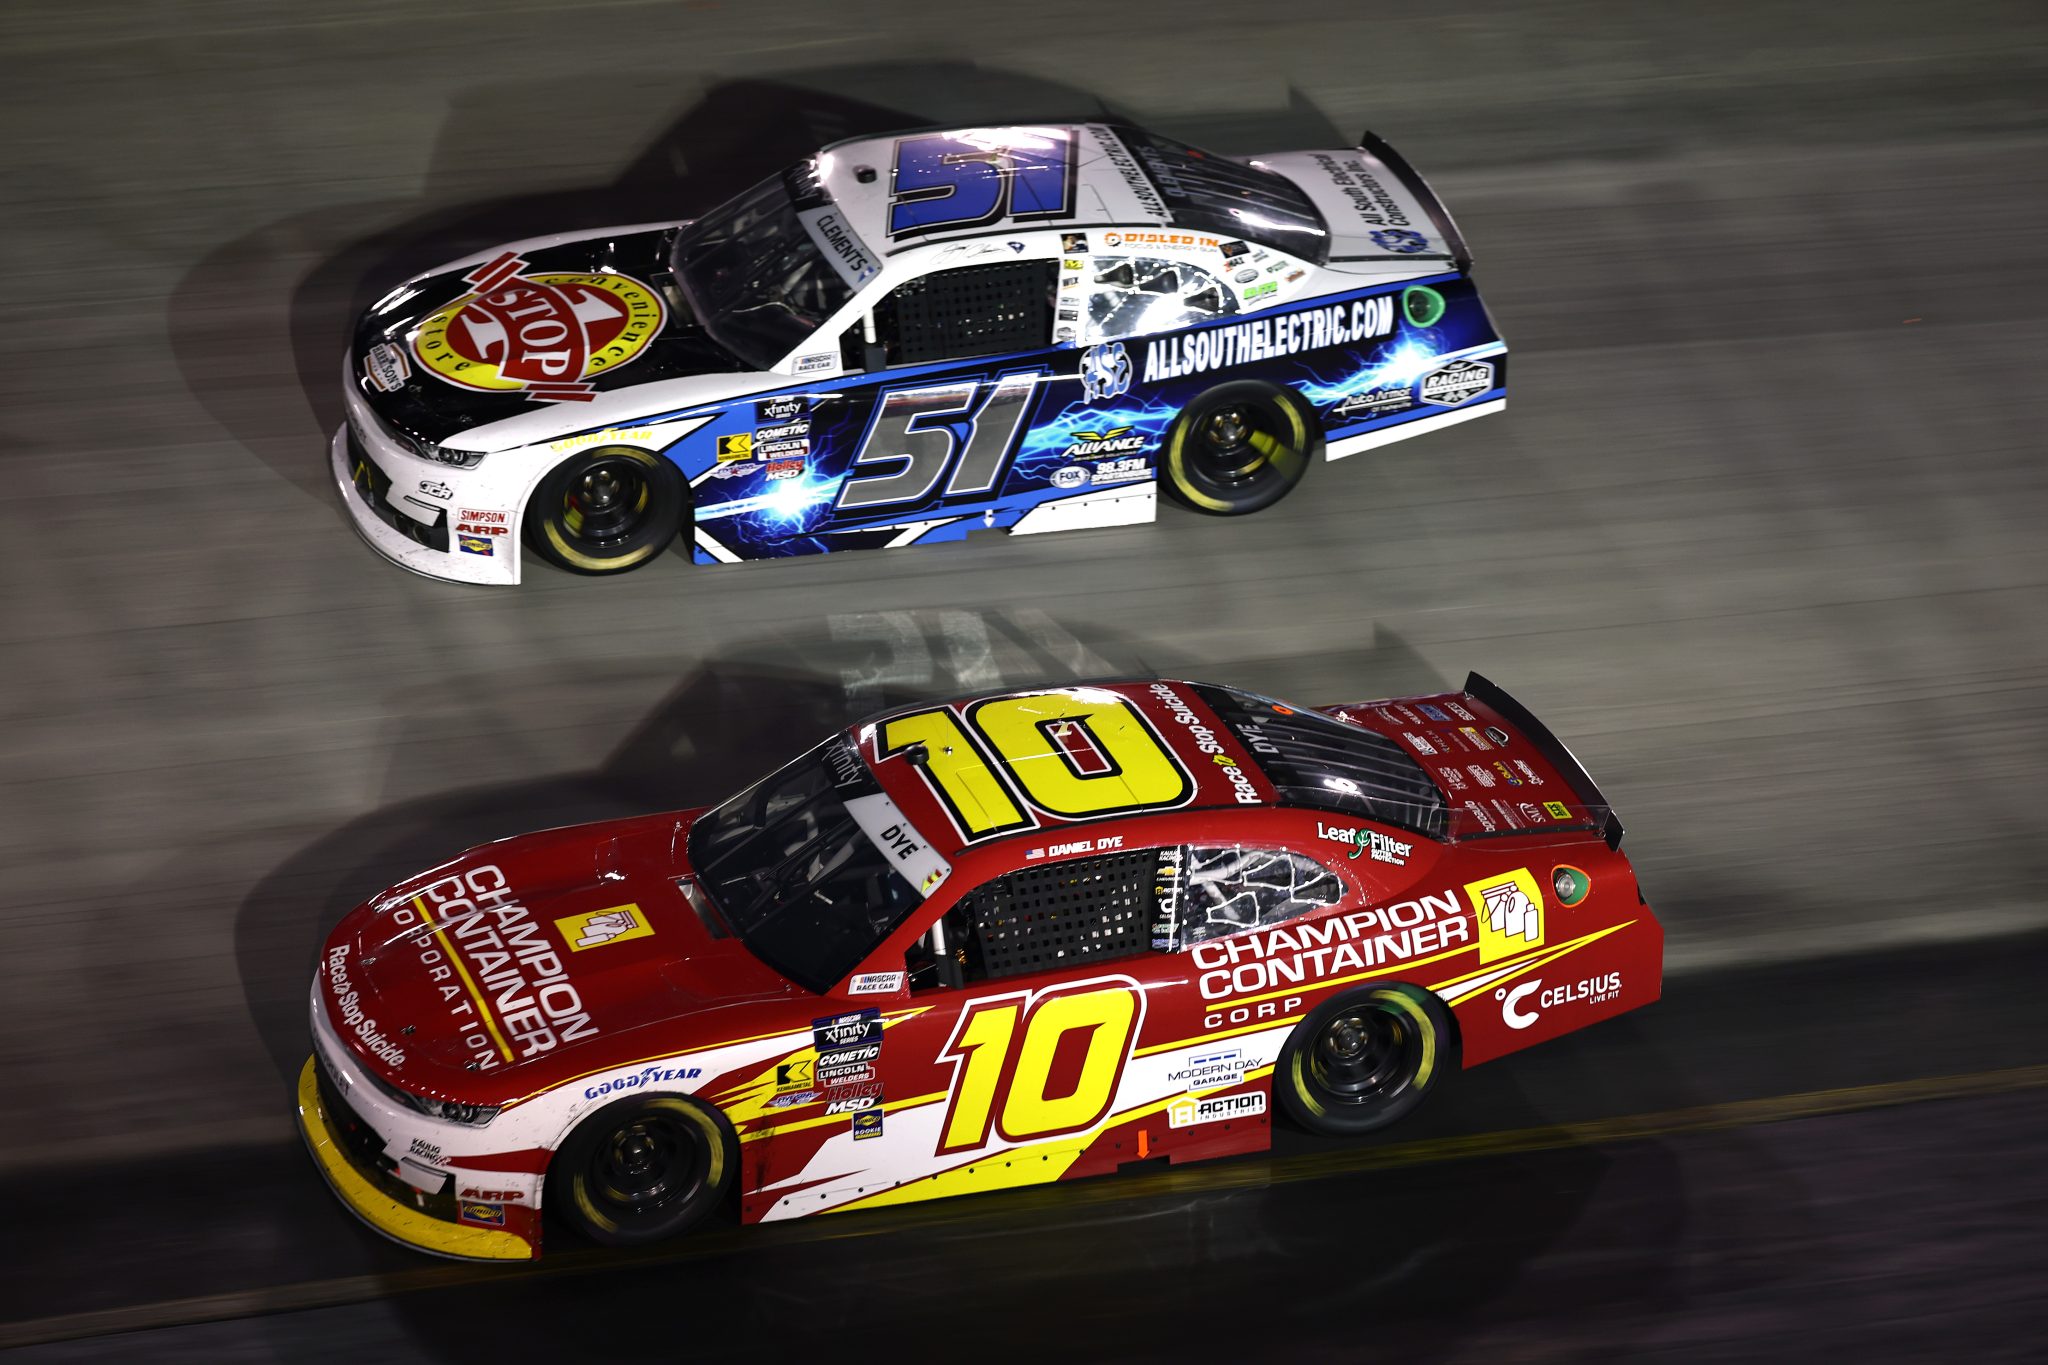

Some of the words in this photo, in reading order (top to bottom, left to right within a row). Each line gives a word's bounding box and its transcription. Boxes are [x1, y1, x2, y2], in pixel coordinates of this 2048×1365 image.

[816, 215, 868, 271] CLEMENTS
[484, 287, 571, 385] STOP
[1142, 296, 1394, 384] ALLSOUTHELECTRIC.COM
[1427, 368, 1487, 388] RACING
[764, 402, 801, 417] xfinity
[756, 424, 810, 440] COMETIC
[837, 373, 1039, 509] 51
[761, 442, 800, 452] LINCOLN
[1061, 436, 1145, 457] ALLIANCE
[765, 470, 800, 482] MSD
[1059, 471, 1081, 480] FOX
[1096, 458, 1146, 474] 98.3FM
[461, 510, 505, 523] SIMPSON
[456, 523, 508, 535] ARP
[1149, 684, 1200, 725] Suicide
[1188, 725, 1224, 754] Stop
[876, 688, 1197, 845] 10
[1222, 766, 1262, 803] Race
[880, 824, 919, 860] DYE
[1048, 840, 1095, 857] DANIEL
[1097, 836, 1124, 850] DYE
[1317, 822, 1356, 844] Leaf
[1366, 830, 1412, 857] Filter
[1190, 889, 1462, 970] CHAMPION
[329, 944, 350, 984] Race
[465, 864, 600, 1043] CHAMPION
[1199, 915, 1469, 999] CONTAINER
[425, 876, 558, 1058] CONTAINER
[856, 983, 877, 991] RACE
[1541, 971, 1621, 1009] CELSIUS
[1590, 994, 1606, 1005] LIVE
[1608, 990, 1620, 1000] FIT
[338, 990, 365, 1026] Stop
[1204, 996, 1302, 1029] CORP
[825, 1022, 871, 1042] xfinity
[354, 1018, 406, 1068] Suicide
[818, 1047, 878, 1066] COMETIC
[938, 980, 1143, 1154] 10
[820, 1064, 865, 1079] LINCOLN
[830, 1073, 870, 1085] WELDERS
[1168, 1062, 1231, 1082] MODERN
[1234, 1057, 1263, 1070] DAY
[1193, 1073, 1237, 1086] GARAGE
[584, 1066, 702, 1100] GOODYEAR
[827, 1083, 884, 1101] Holley
[825, 1098, 875, 1115] MSD
[1198, 1094, 1263, 1115] ACTION
[1200, 1106, 1263, 1120] INDUSTRIES
[855, 1127, 881, 1136] ROOKIE
[460, 1188, 525, 1201] ARP
